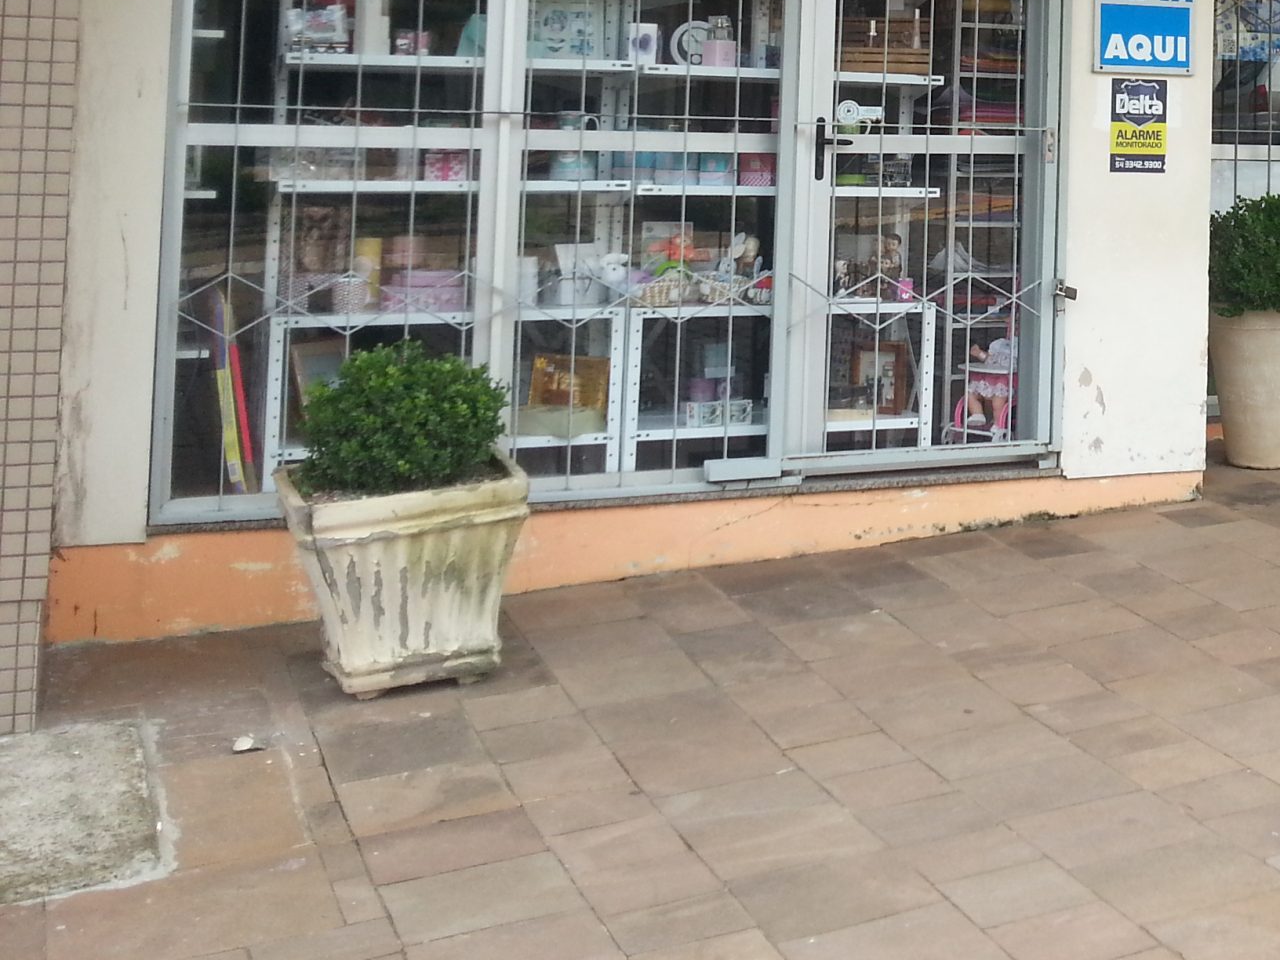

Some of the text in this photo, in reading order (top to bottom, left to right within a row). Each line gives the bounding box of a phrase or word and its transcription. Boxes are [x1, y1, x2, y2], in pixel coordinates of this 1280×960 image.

[1103, 33, 1187, 62] AQUI
[1115, 93, 1163, 115] Delta
[1116, 129, 1162, 141] ALARME
